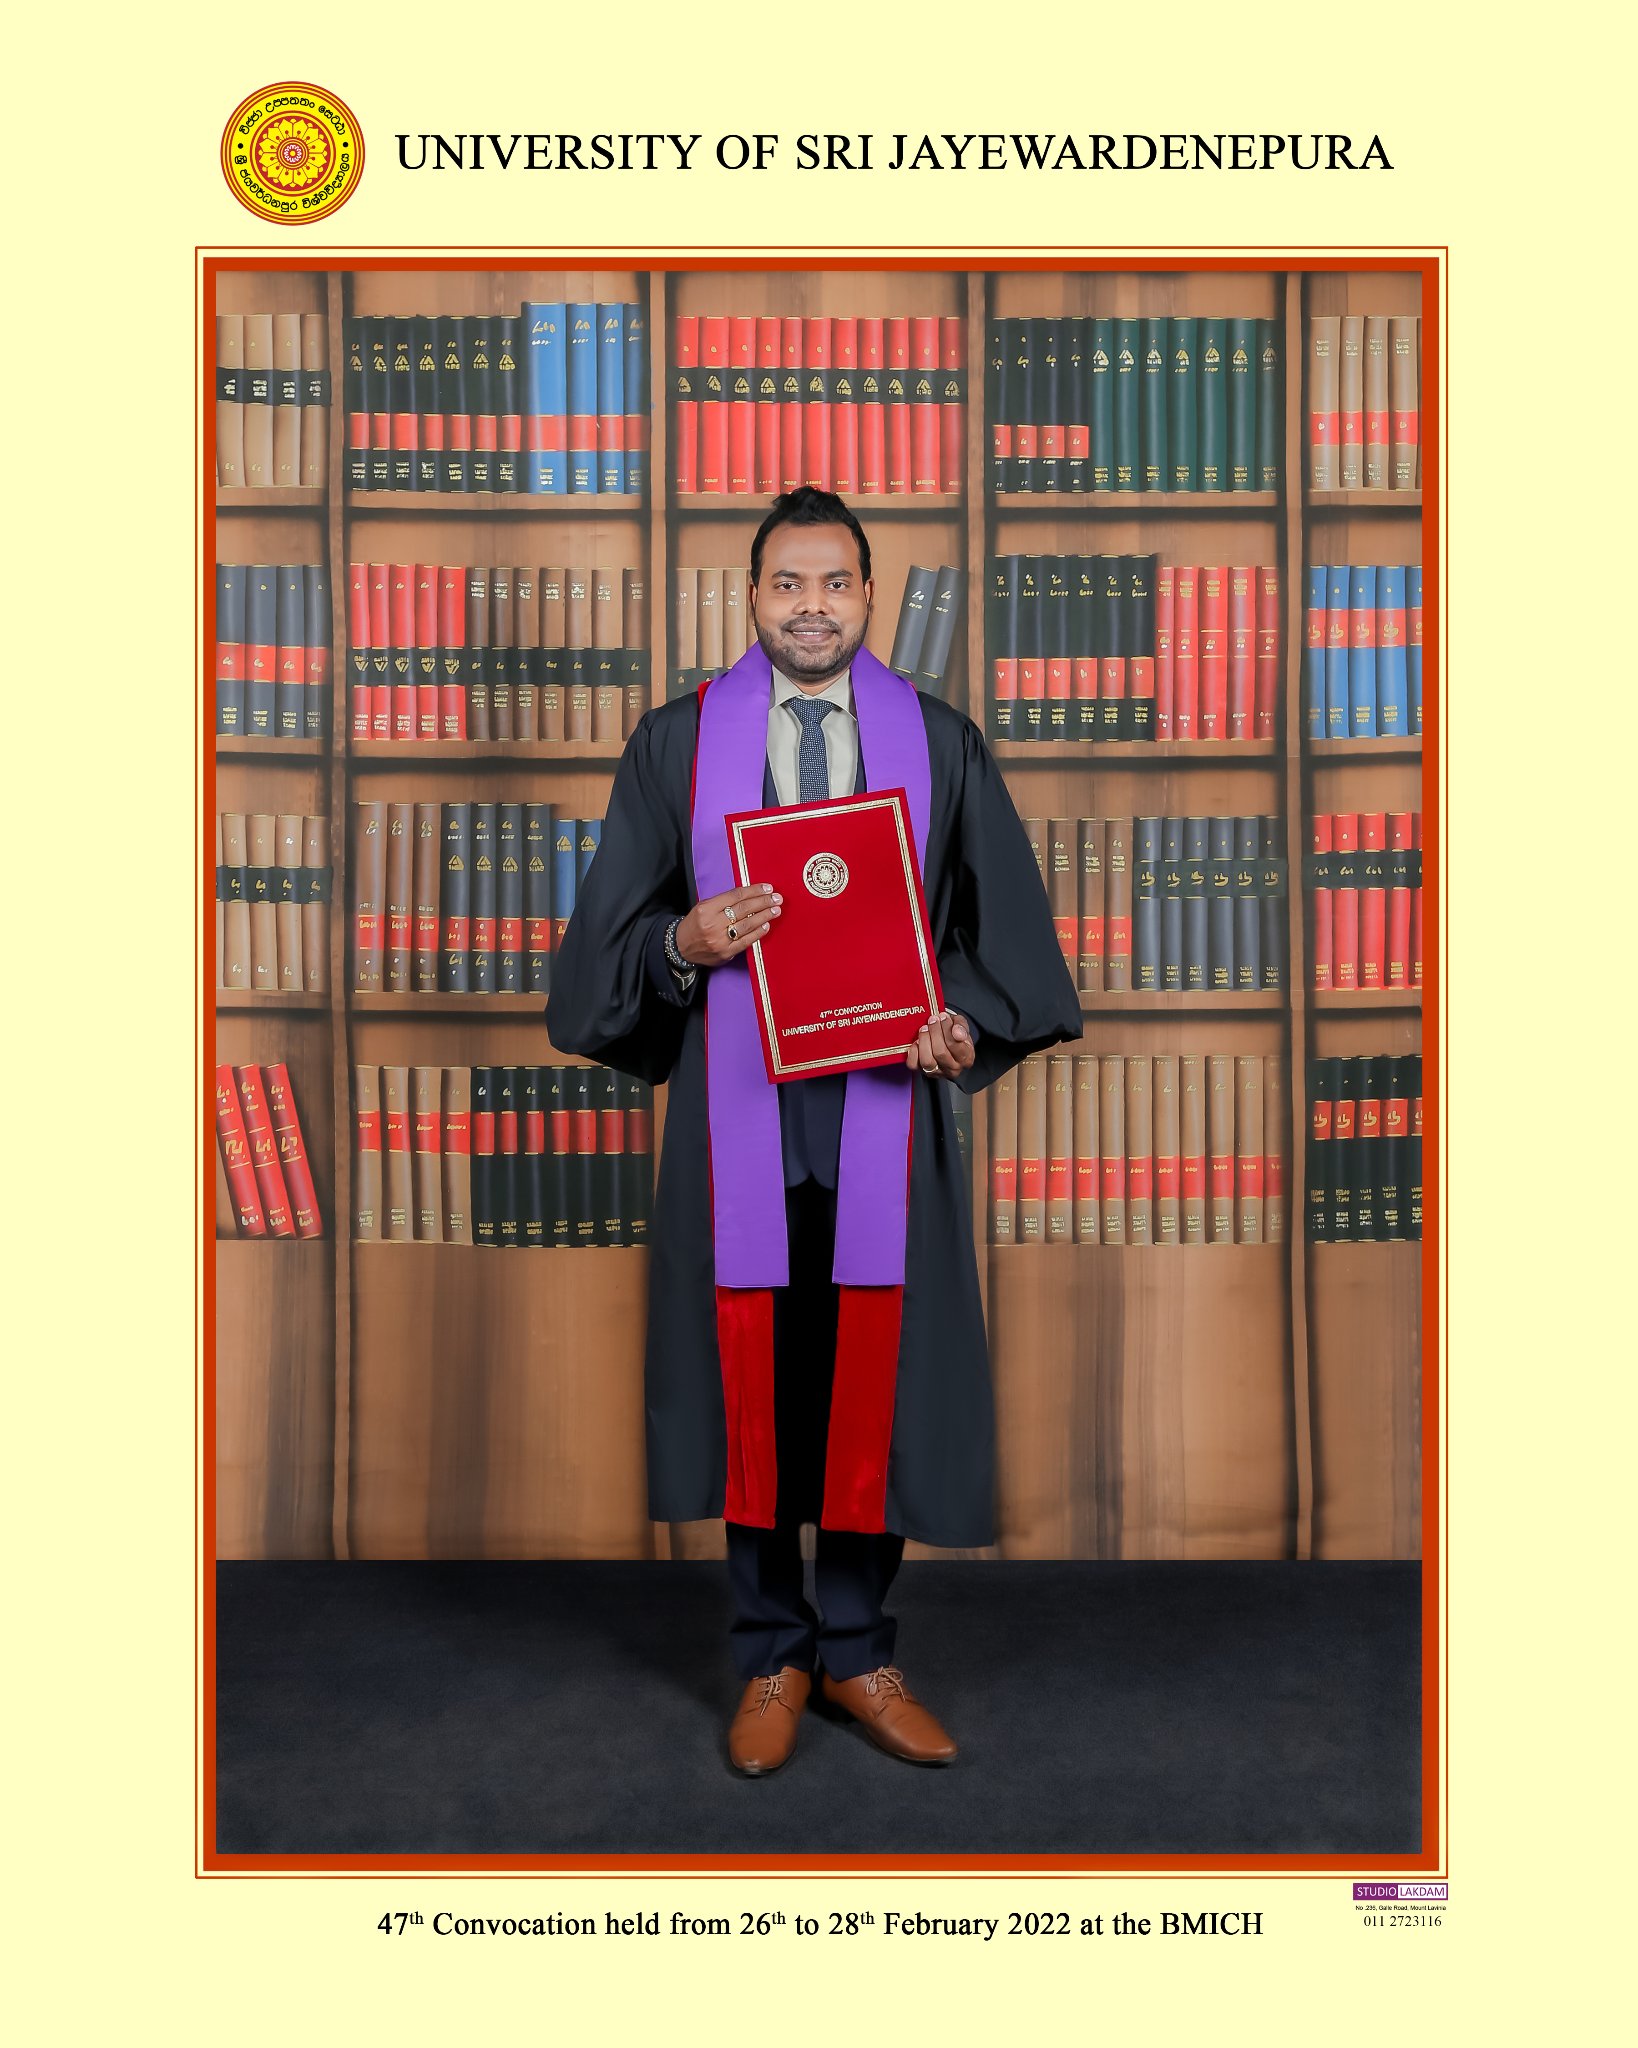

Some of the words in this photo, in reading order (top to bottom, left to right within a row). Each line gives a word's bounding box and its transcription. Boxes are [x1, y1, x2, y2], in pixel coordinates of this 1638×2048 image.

[781, 1022, 825, 1037] UNIVERSITY
[826, 1020, 837, 1029] OF
[837, 1018, 851, 1028] SRI
[851, 1005, 926, 1026] JAYEWARDENEPURA
[833, 1001, 883, 1017] CONVOCATION
